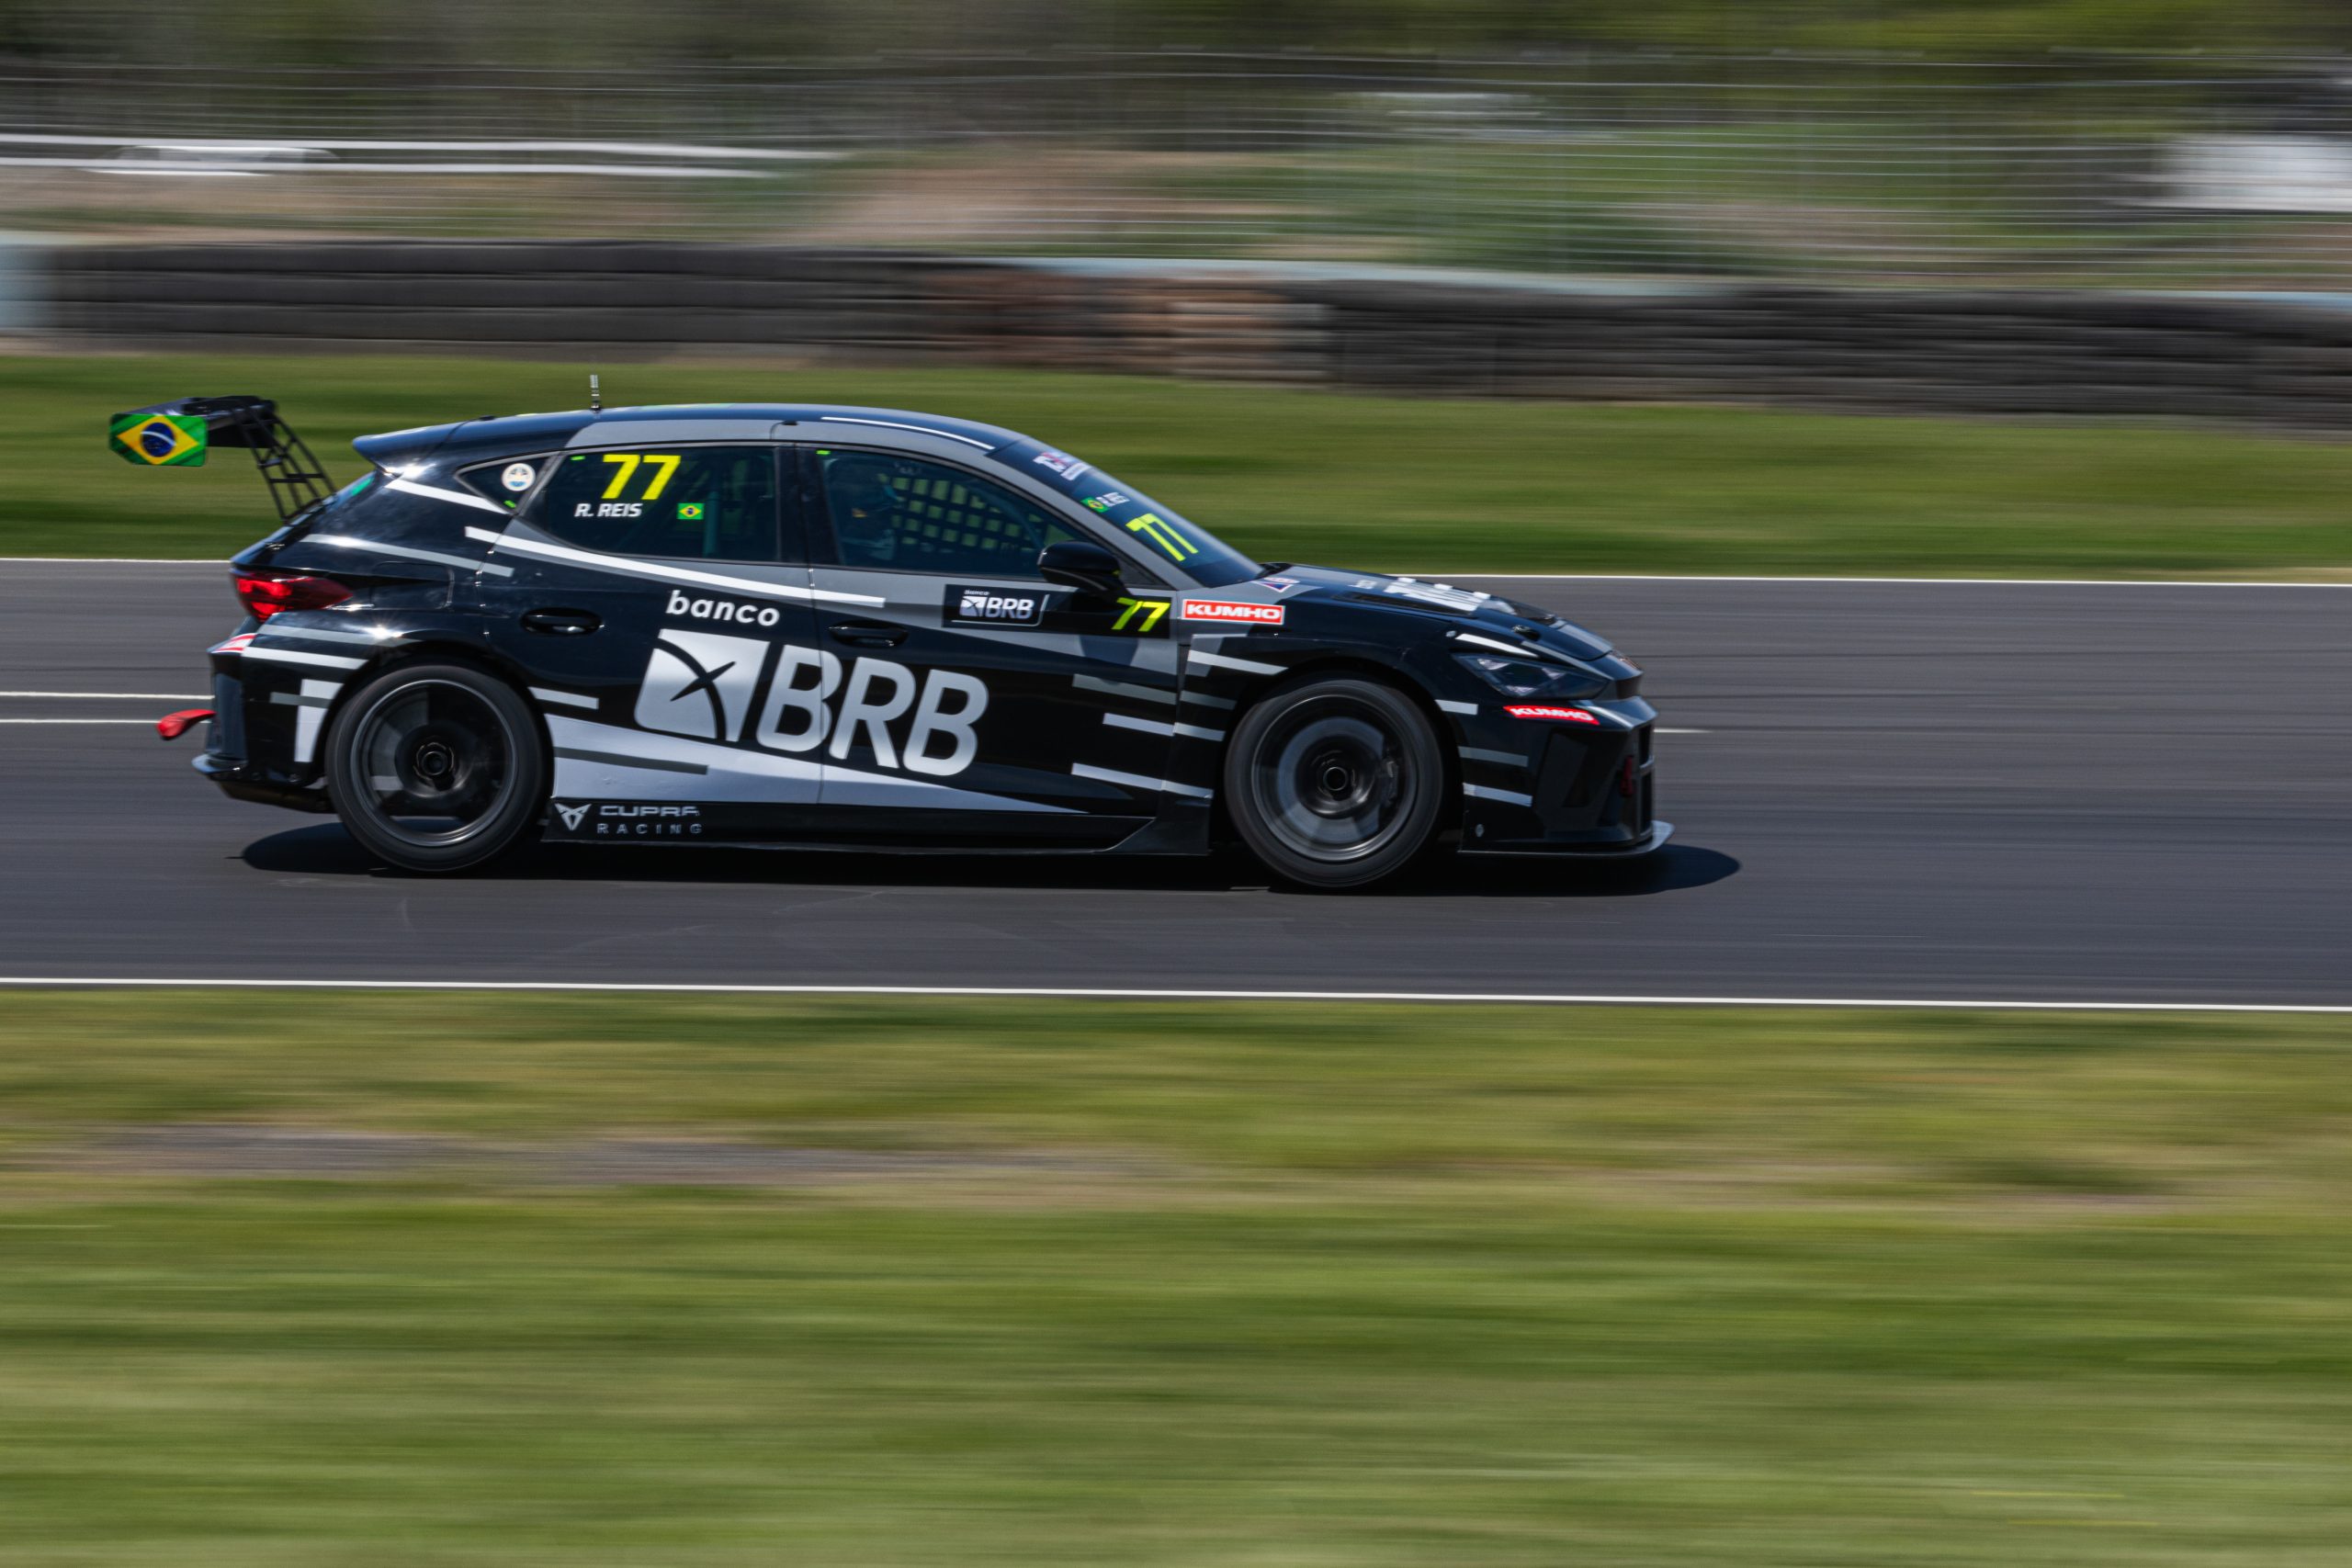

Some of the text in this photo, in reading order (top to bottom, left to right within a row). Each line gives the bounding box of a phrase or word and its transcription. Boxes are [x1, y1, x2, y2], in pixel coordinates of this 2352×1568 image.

[601, 454, 682, 500] 77
[574, 502, 643, 517] R. REIS
[1125, 513, 1198, 562] 77
[665, 590, 781, 627] banco
[985, 597, 1035, 619] BRB
[1111, 597, 1170, 632] 77
[1187, 604, 1281, 620] KUMHO
[756, 644, 989, 777] BRB
[599, 805, 700, 817] CUPRA
[596, 823, 703, 834] RACING
